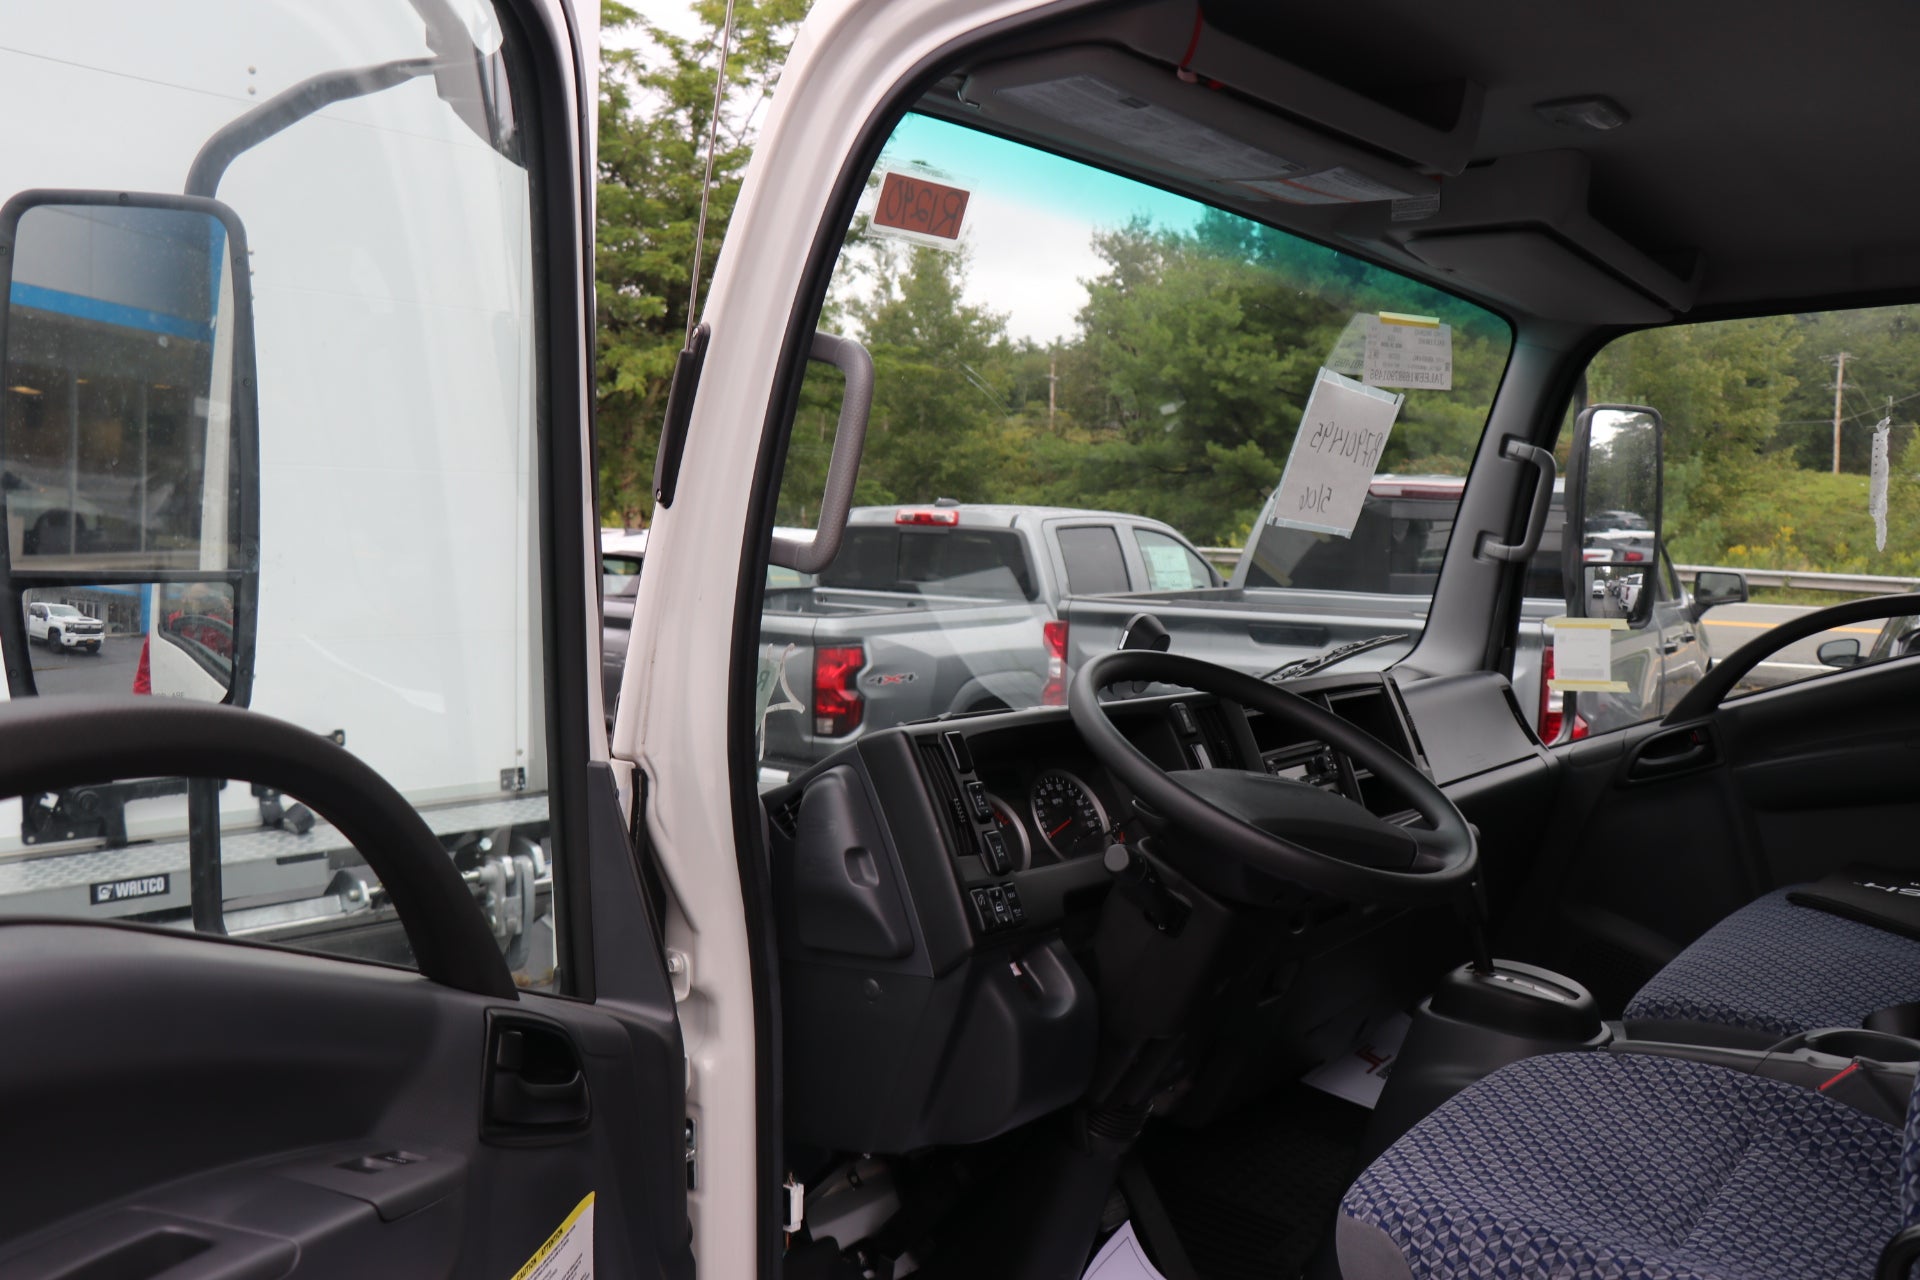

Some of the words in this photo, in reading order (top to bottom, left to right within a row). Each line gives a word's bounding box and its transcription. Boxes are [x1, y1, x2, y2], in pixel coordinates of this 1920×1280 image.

[115, 876, 165, 898] WALTCO
[516, 1256, 537, 1280] CAUTION
[540, 1227, 564, 1257] ATTENTION
